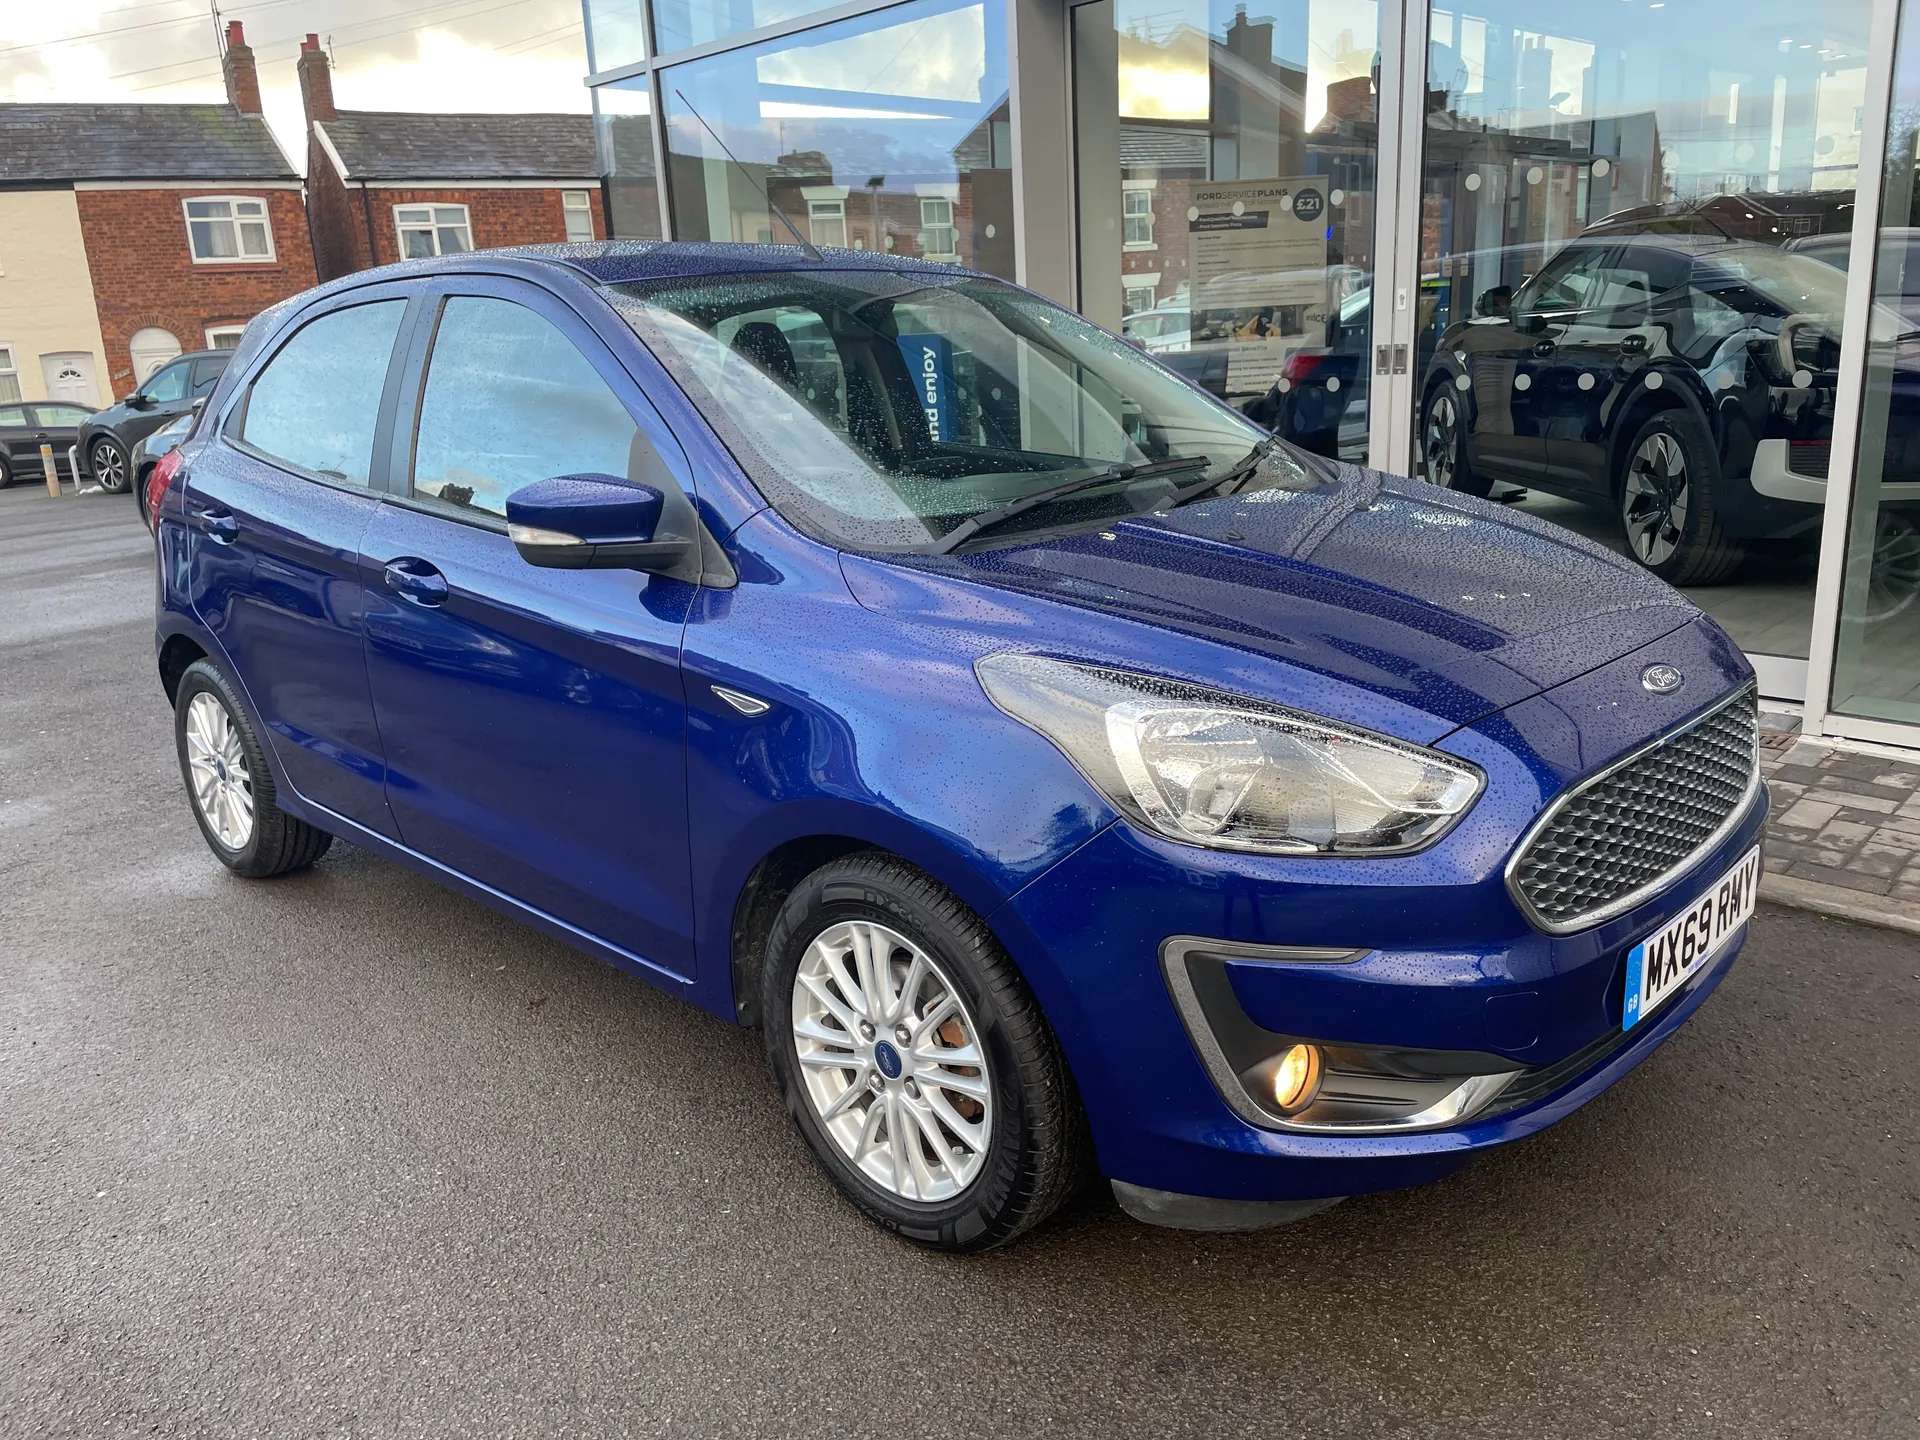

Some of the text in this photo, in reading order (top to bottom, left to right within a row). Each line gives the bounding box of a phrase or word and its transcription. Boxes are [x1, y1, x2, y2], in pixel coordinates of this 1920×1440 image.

[1296, 198, 1320, 210] £21
[922, 346, 938, 404] enjoy
[1645, 855, 1756, 1001] MX69 RMY
[1628, 994, 1638, 1013] GB
